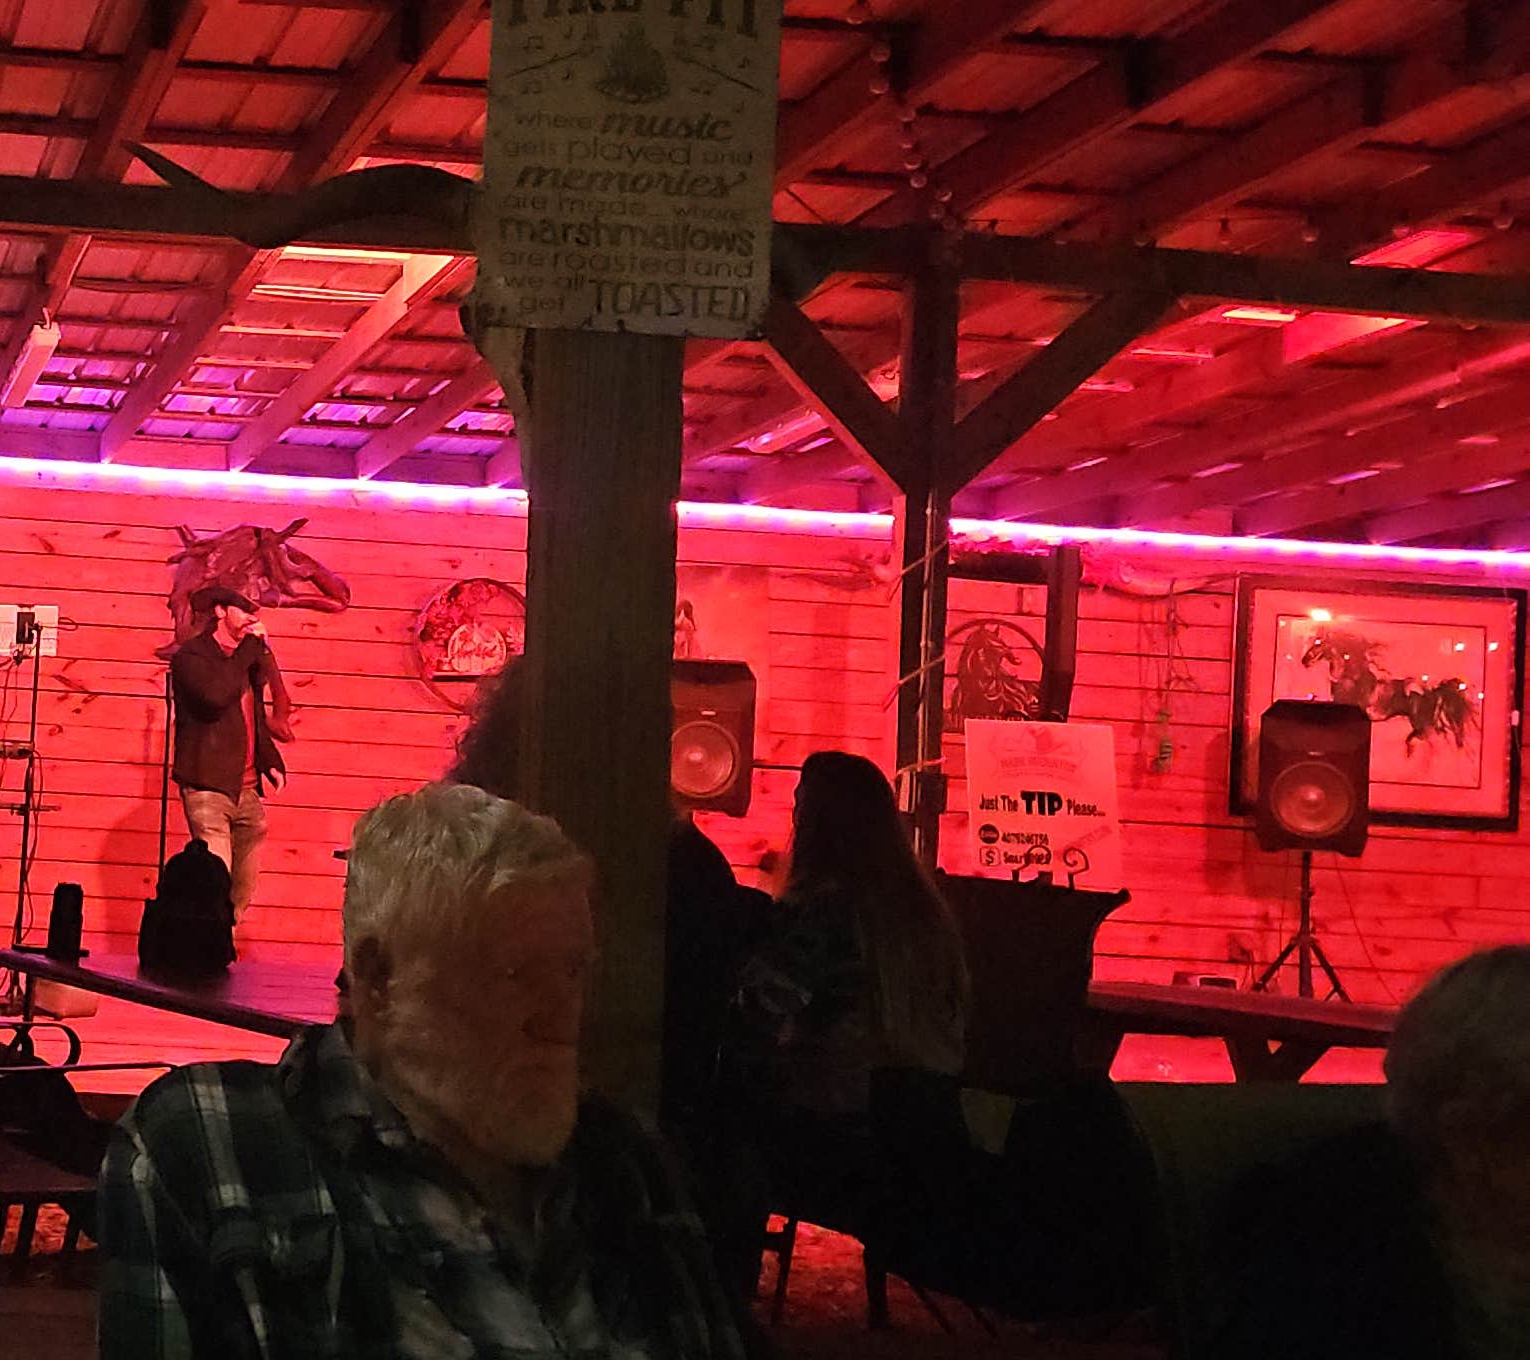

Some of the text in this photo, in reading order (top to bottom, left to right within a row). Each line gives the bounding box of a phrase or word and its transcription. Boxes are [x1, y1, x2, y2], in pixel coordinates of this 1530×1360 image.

[516, 111, 734, 141] where music
[568, 137, 692, 166] played
[702, 149, 754, 167] and
[516, 166, 747, 198] memories
[498, 216, 757, 257] marshmallows
[499, 249, 754, 280] are roasted and
[519, 280, 751, 321] get TOASTED
[979, 794, 999, 811] Just
[1000, 795, 1018, 812] The
[1020, 790, 1063, 816] TIP
